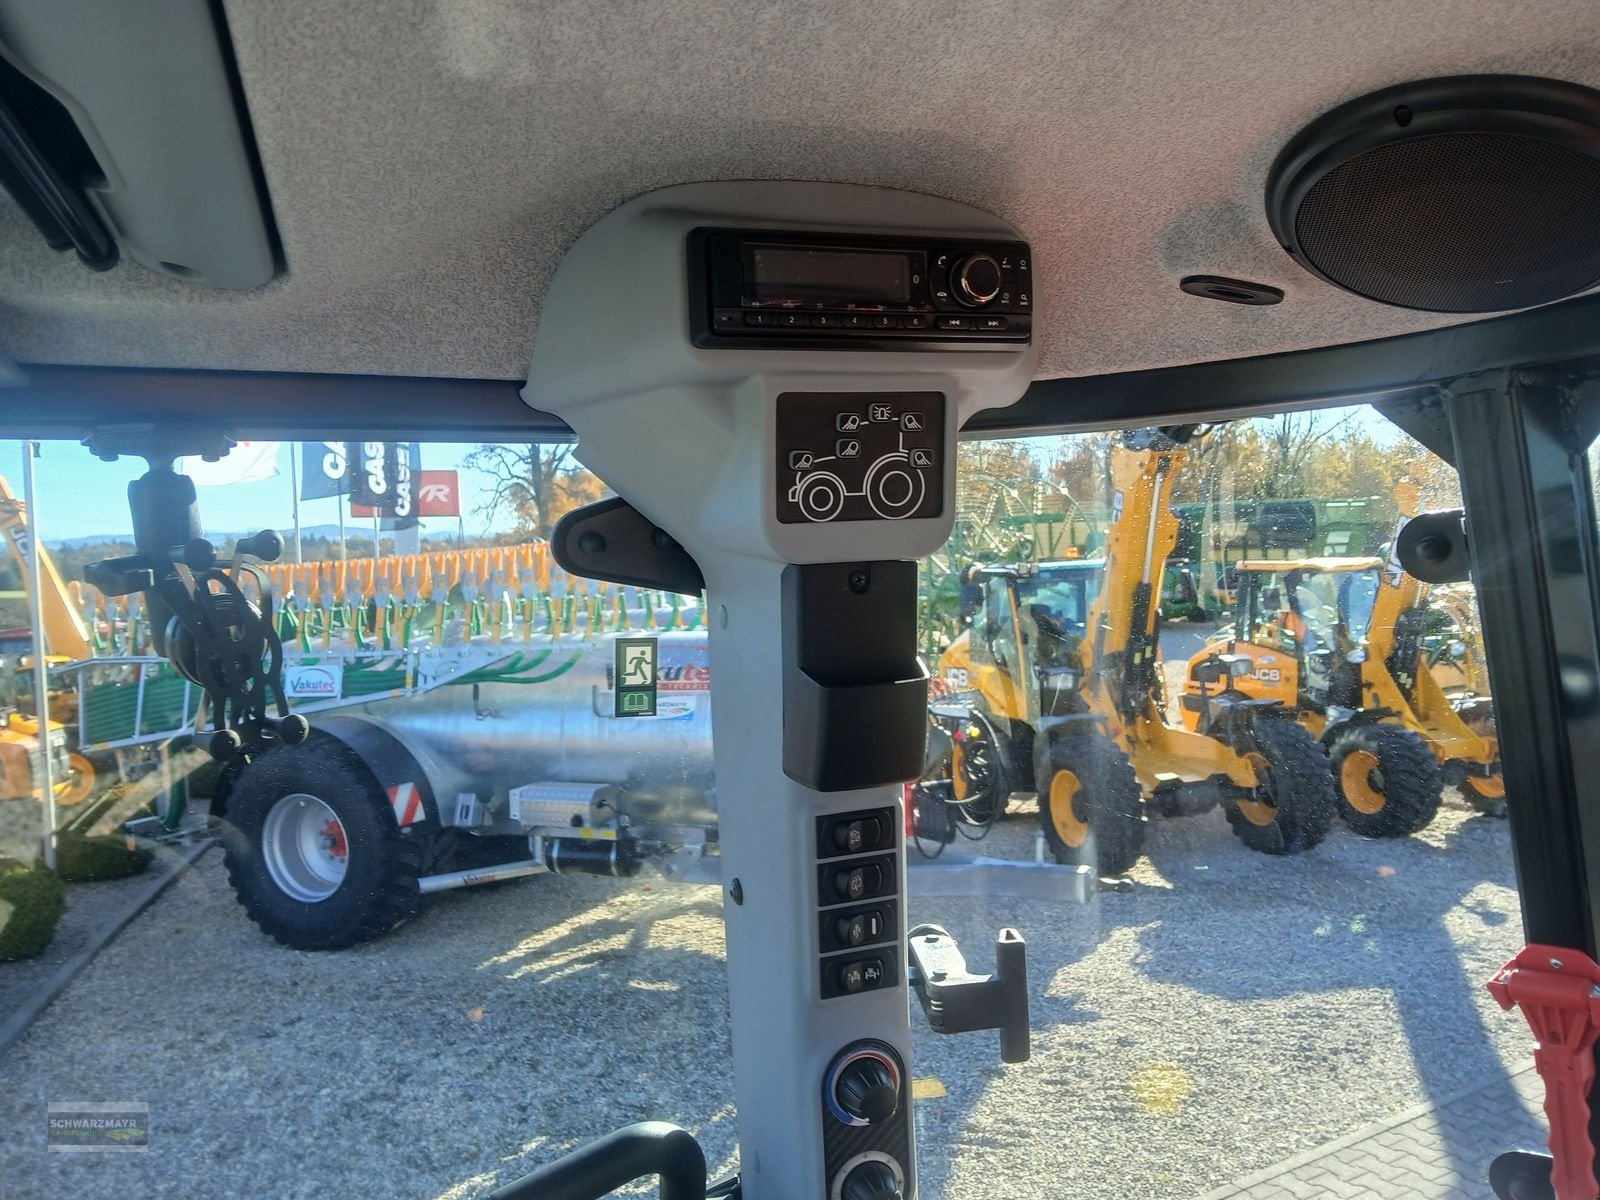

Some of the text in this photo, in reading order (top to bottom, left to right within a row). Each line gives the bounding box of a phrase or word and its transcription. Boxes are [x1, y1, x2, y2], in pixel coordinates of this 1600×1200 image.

[788, 316, 795, 324] 2
[1250, 668, 1281, 681] JCB
[290, 676, 334, 693] Vakutec
